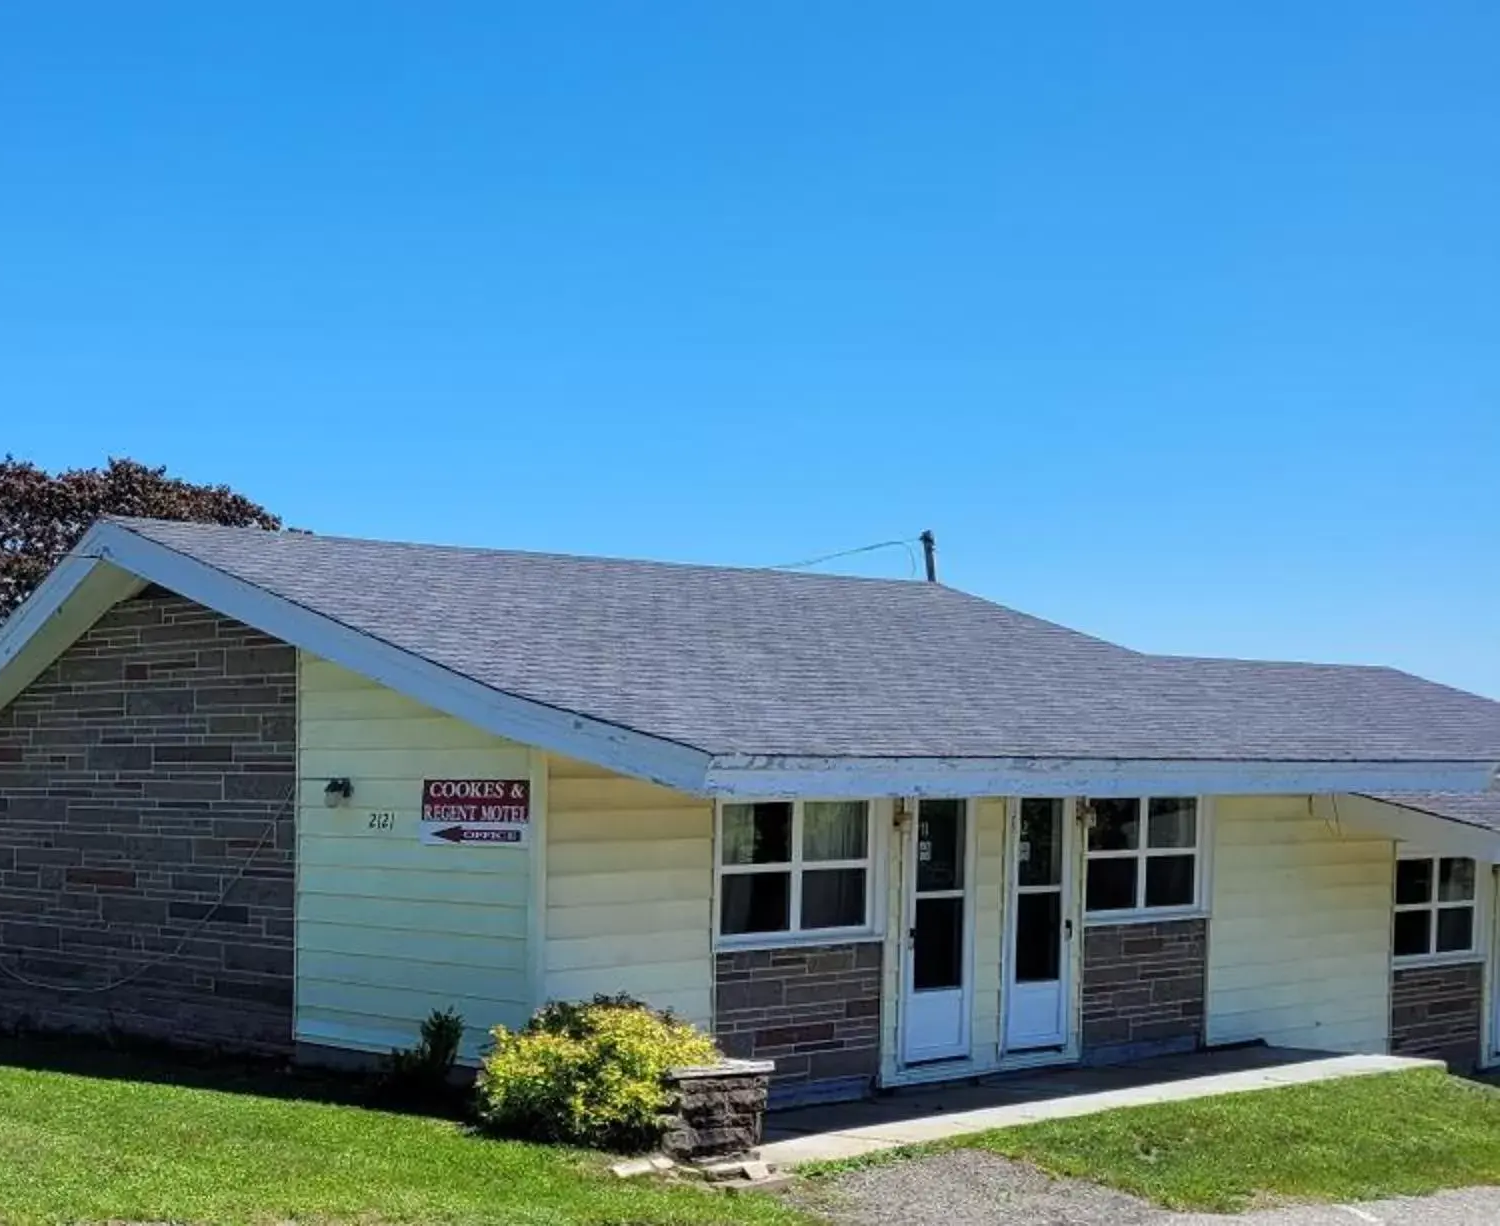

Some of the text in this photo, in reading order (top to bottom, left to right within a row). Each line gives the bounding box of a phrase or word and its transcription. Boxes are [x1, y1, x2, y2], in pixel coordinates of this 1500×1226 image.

[429, 781, 525, 799] COOKES &
[423, 803, 529, 822] REGENT MOTEL
[463, 831, 517, 840] OFFICE
